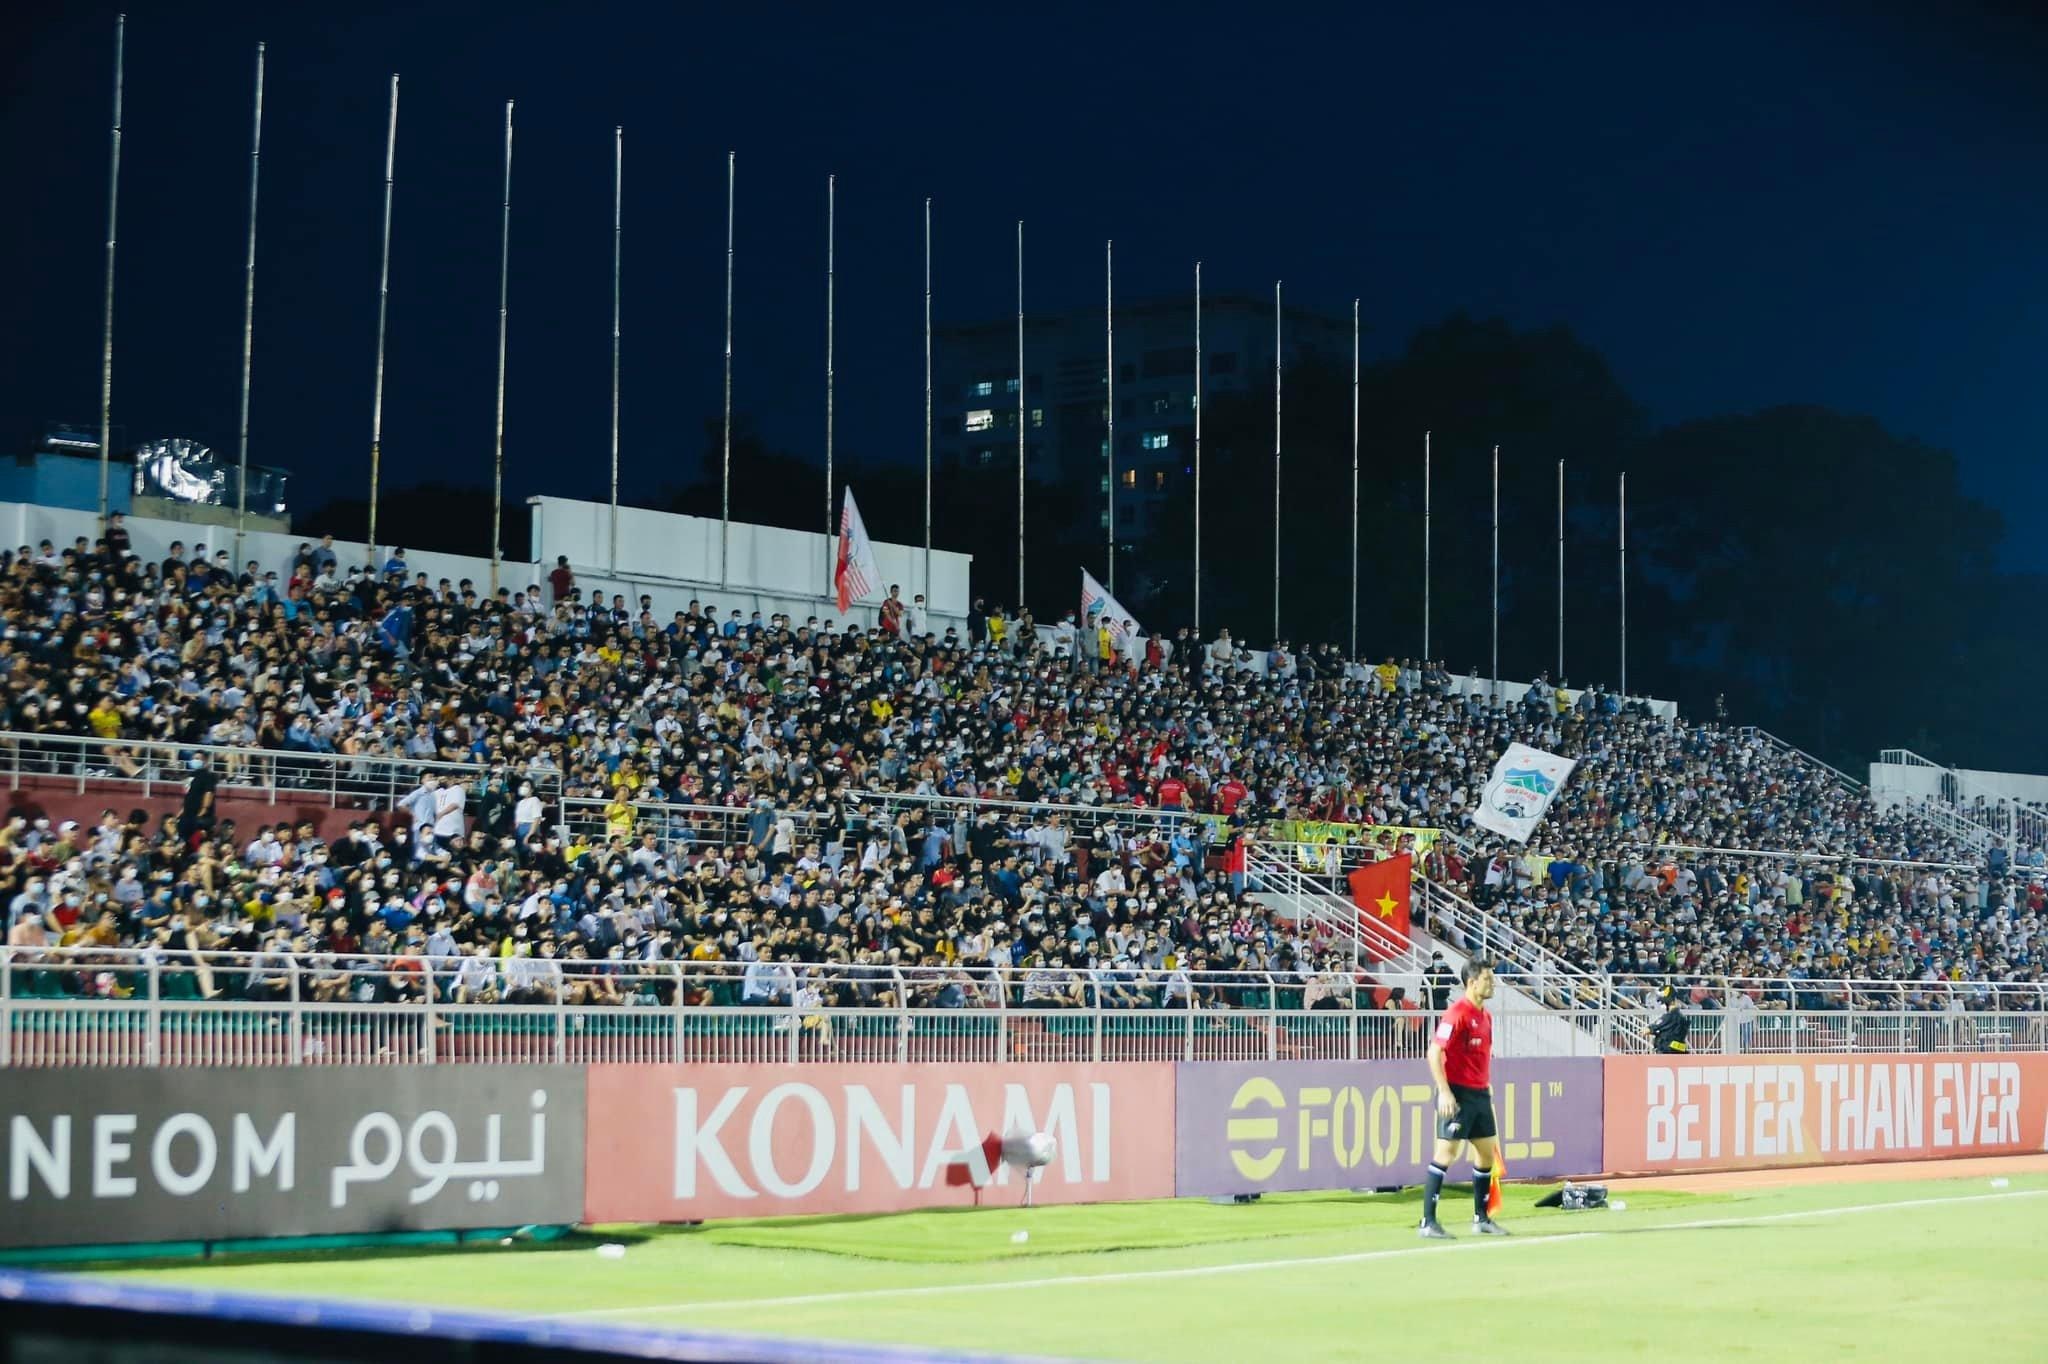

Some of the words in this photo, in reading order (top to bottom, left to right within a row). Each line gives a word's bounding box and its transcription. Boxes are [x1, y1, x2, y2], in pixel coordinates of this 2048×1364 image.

[10, 1112, 296, 1199] NEOM
[331, 1089, 547, 1208] نيوم
[673, 1082, 1111, 1199] KONAMI
[1646, 1065, 1805, 1161] BETTER
[1815, 1063, 1924, 1152] THAN
[1933, 1061, 2021, 1147] EVER
